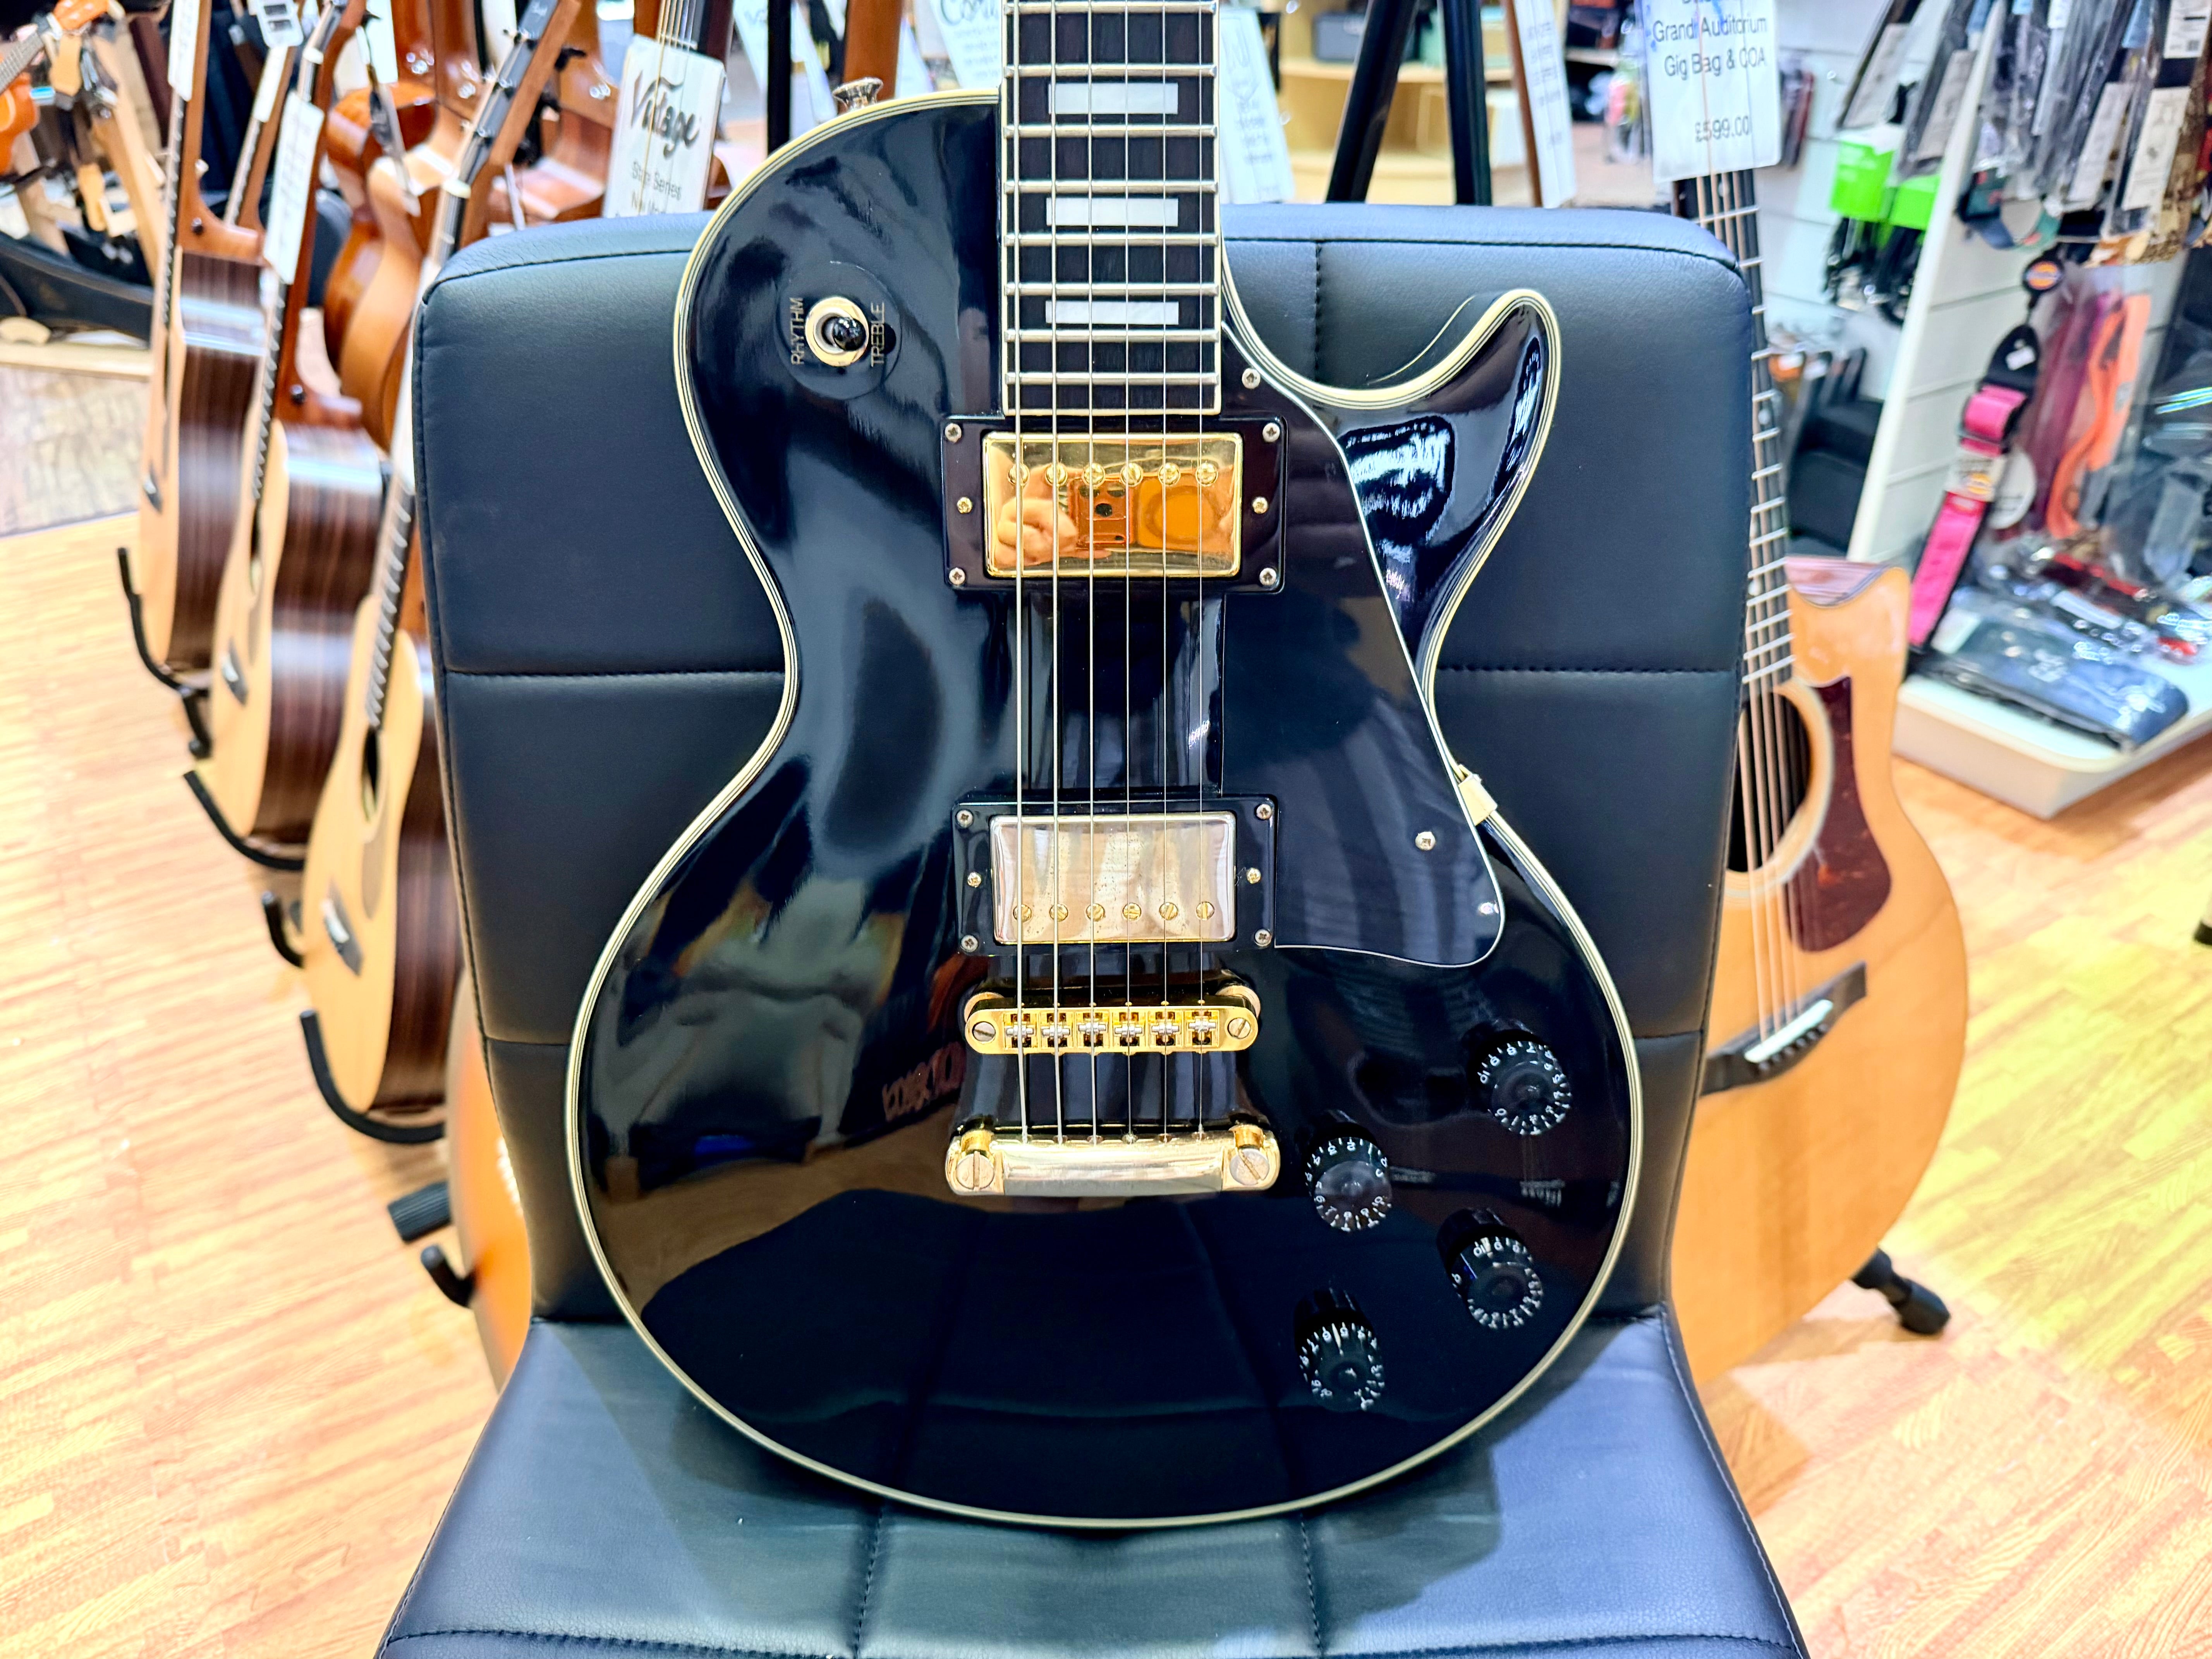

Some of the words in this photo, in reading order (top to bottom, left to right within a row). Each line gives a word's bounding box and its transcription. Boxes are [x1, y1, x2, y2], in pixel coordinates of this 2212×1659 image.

[1652, 17, 1695, 42] Grand
[1701, 14, 1767, 37] Auditorium
[1664, 55, 1688, 81] Gig
[1691, 53, 1721, 76] Bag
[1726, 48, 1735, 70] &
[1695, 115, 1749, 143] £599.00
[790, 297, 804, 365] RHYTHM
[871, 301, 884, 367] TREBLE
